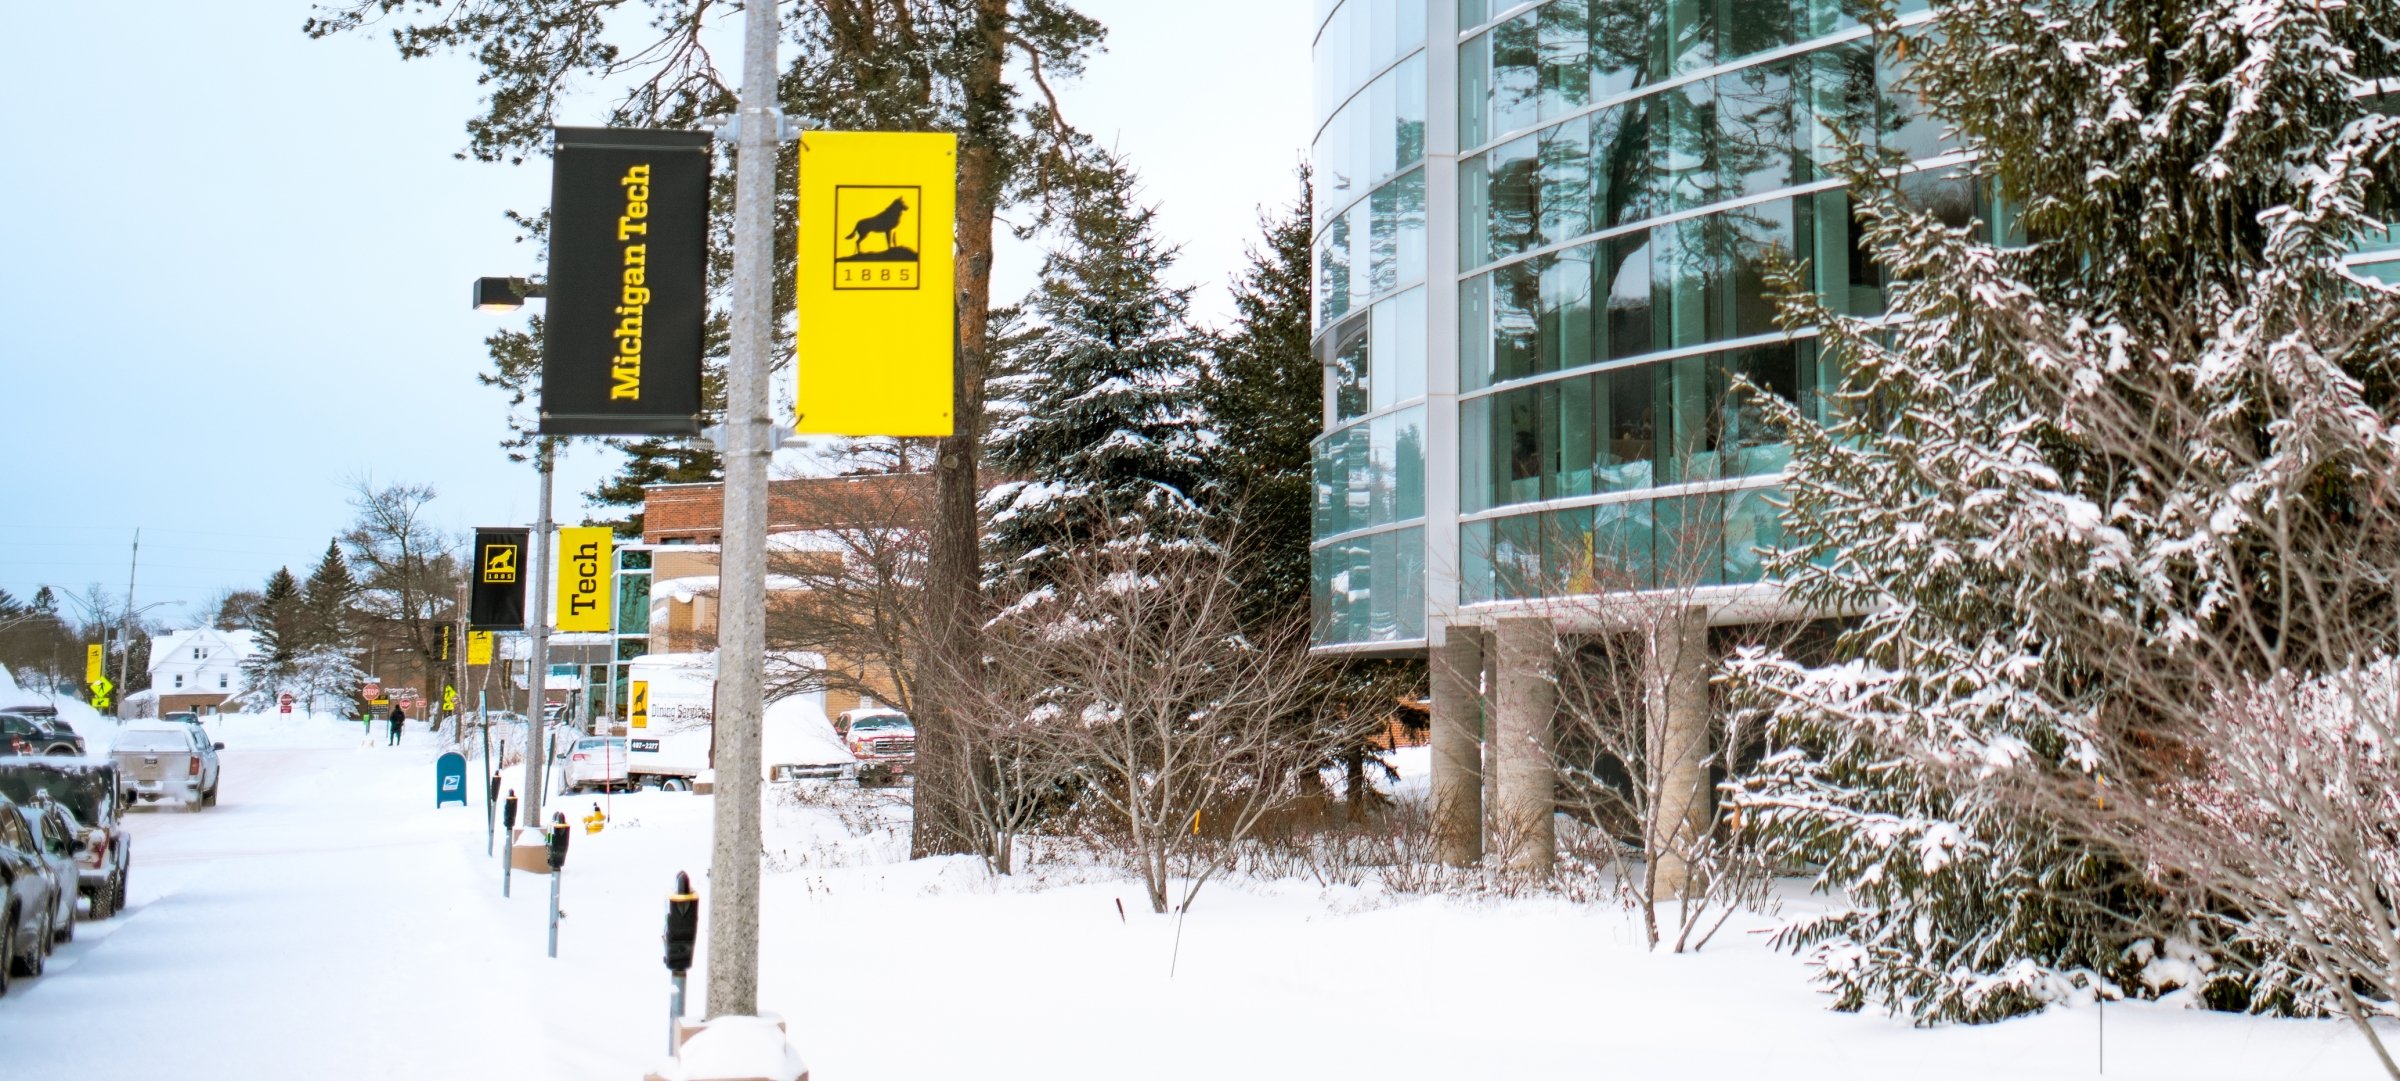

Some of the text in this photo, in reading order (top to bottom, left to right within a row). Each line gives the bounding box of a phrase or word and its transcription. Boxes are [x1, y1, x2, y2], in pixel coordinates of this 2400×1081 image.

[609, 163, 651, 401] Michigan Tech
[843, 268, 910, 282] 1885
[487, 572, 512, 580] 1885
[571, 541, 599, 616] Tech
[364, 688, 379, 696] STOP
[651, 703, 713, 722] Dining Services
